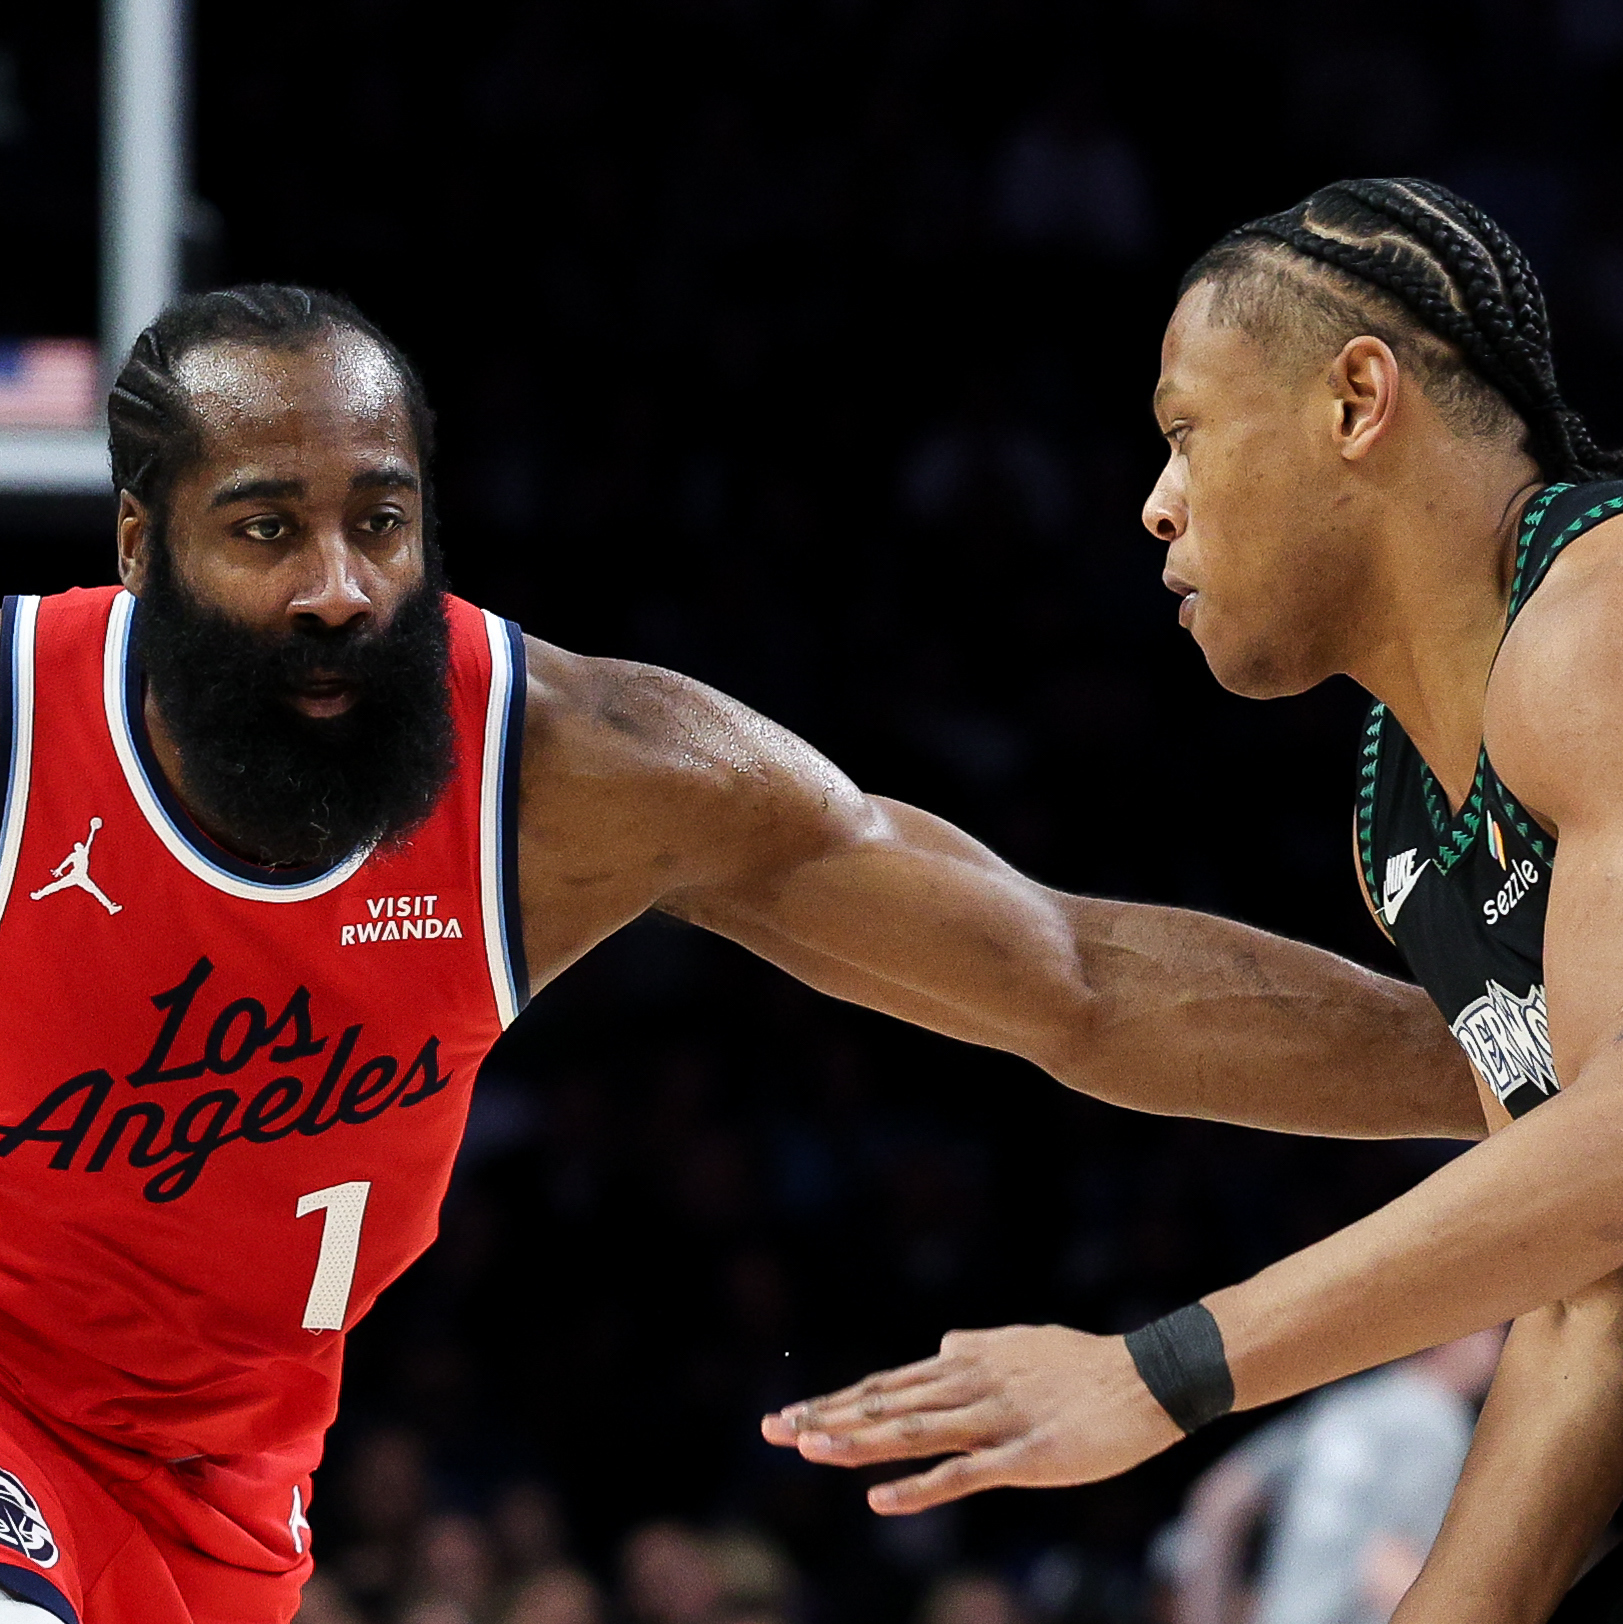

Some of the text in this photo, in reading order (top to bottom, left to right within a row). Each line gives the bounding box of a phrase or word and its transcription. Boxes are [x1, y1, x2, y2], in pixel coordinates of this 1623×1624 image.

[1385, 848, 1418, 896] NIKE
[1483, 859, 1539, 925] sezzle
[341, 918, 463, 946] RWANDA
[366, 895, 438, 919] VISIT
[125, 956, 328, 1088] Los
[295, 1181, 372, 1330] 1
